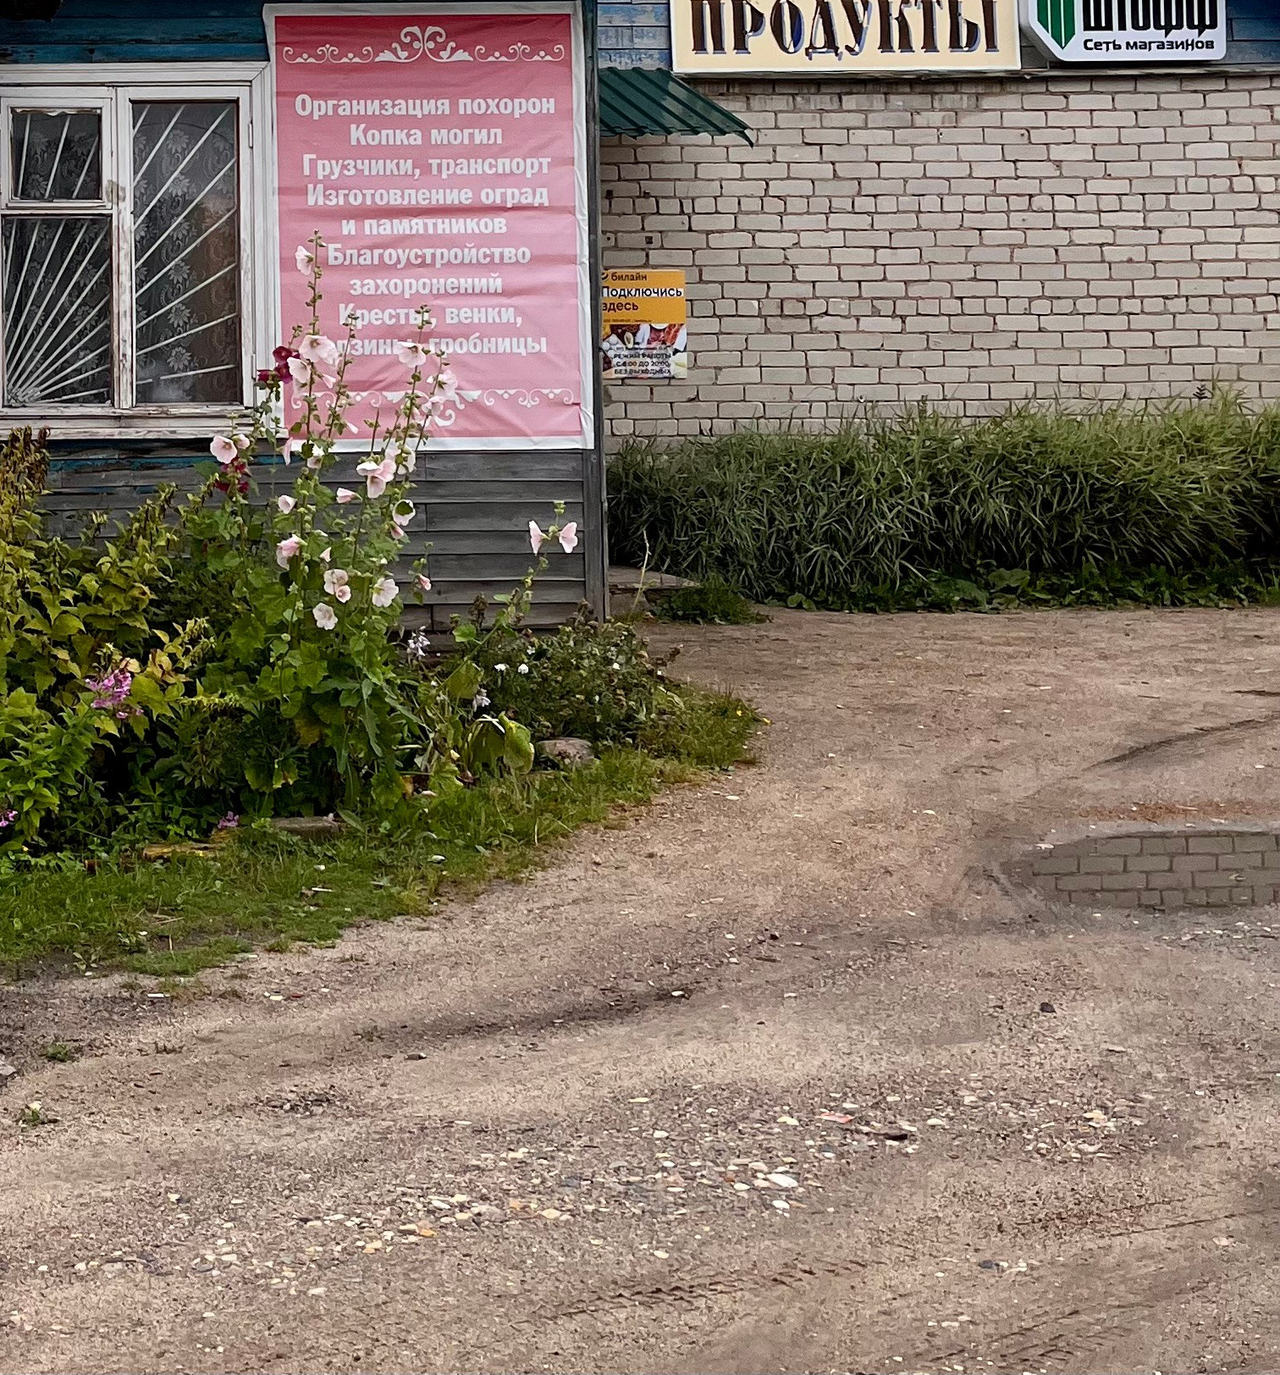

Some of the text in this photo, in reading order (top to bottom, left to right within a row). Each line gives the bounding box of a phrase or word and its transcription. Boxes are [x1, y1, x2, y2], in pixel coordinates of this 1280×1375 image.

[1083, 38, 1122, 52] Сеть
[295, 94, 556, 119] Организация похорон
[350, 125, 503, 147] Копка могил
[303, 154, 552, 179] Грузчики, транспорт
[307, 184, 550, 208] Изготовление оград
[341, 218, 508, 236] и памятников
[327, 242, 531, 268] Благоустройство
[349, 273, 503, 298] захоронений
[611, 272, 647, 281] билайн
[602, 286, 682, 298] Подключись
[446, 306, 523, 329] венки,
[602, 302, 639, 313] здесь
[428, 332, 548, 357] гробницы
